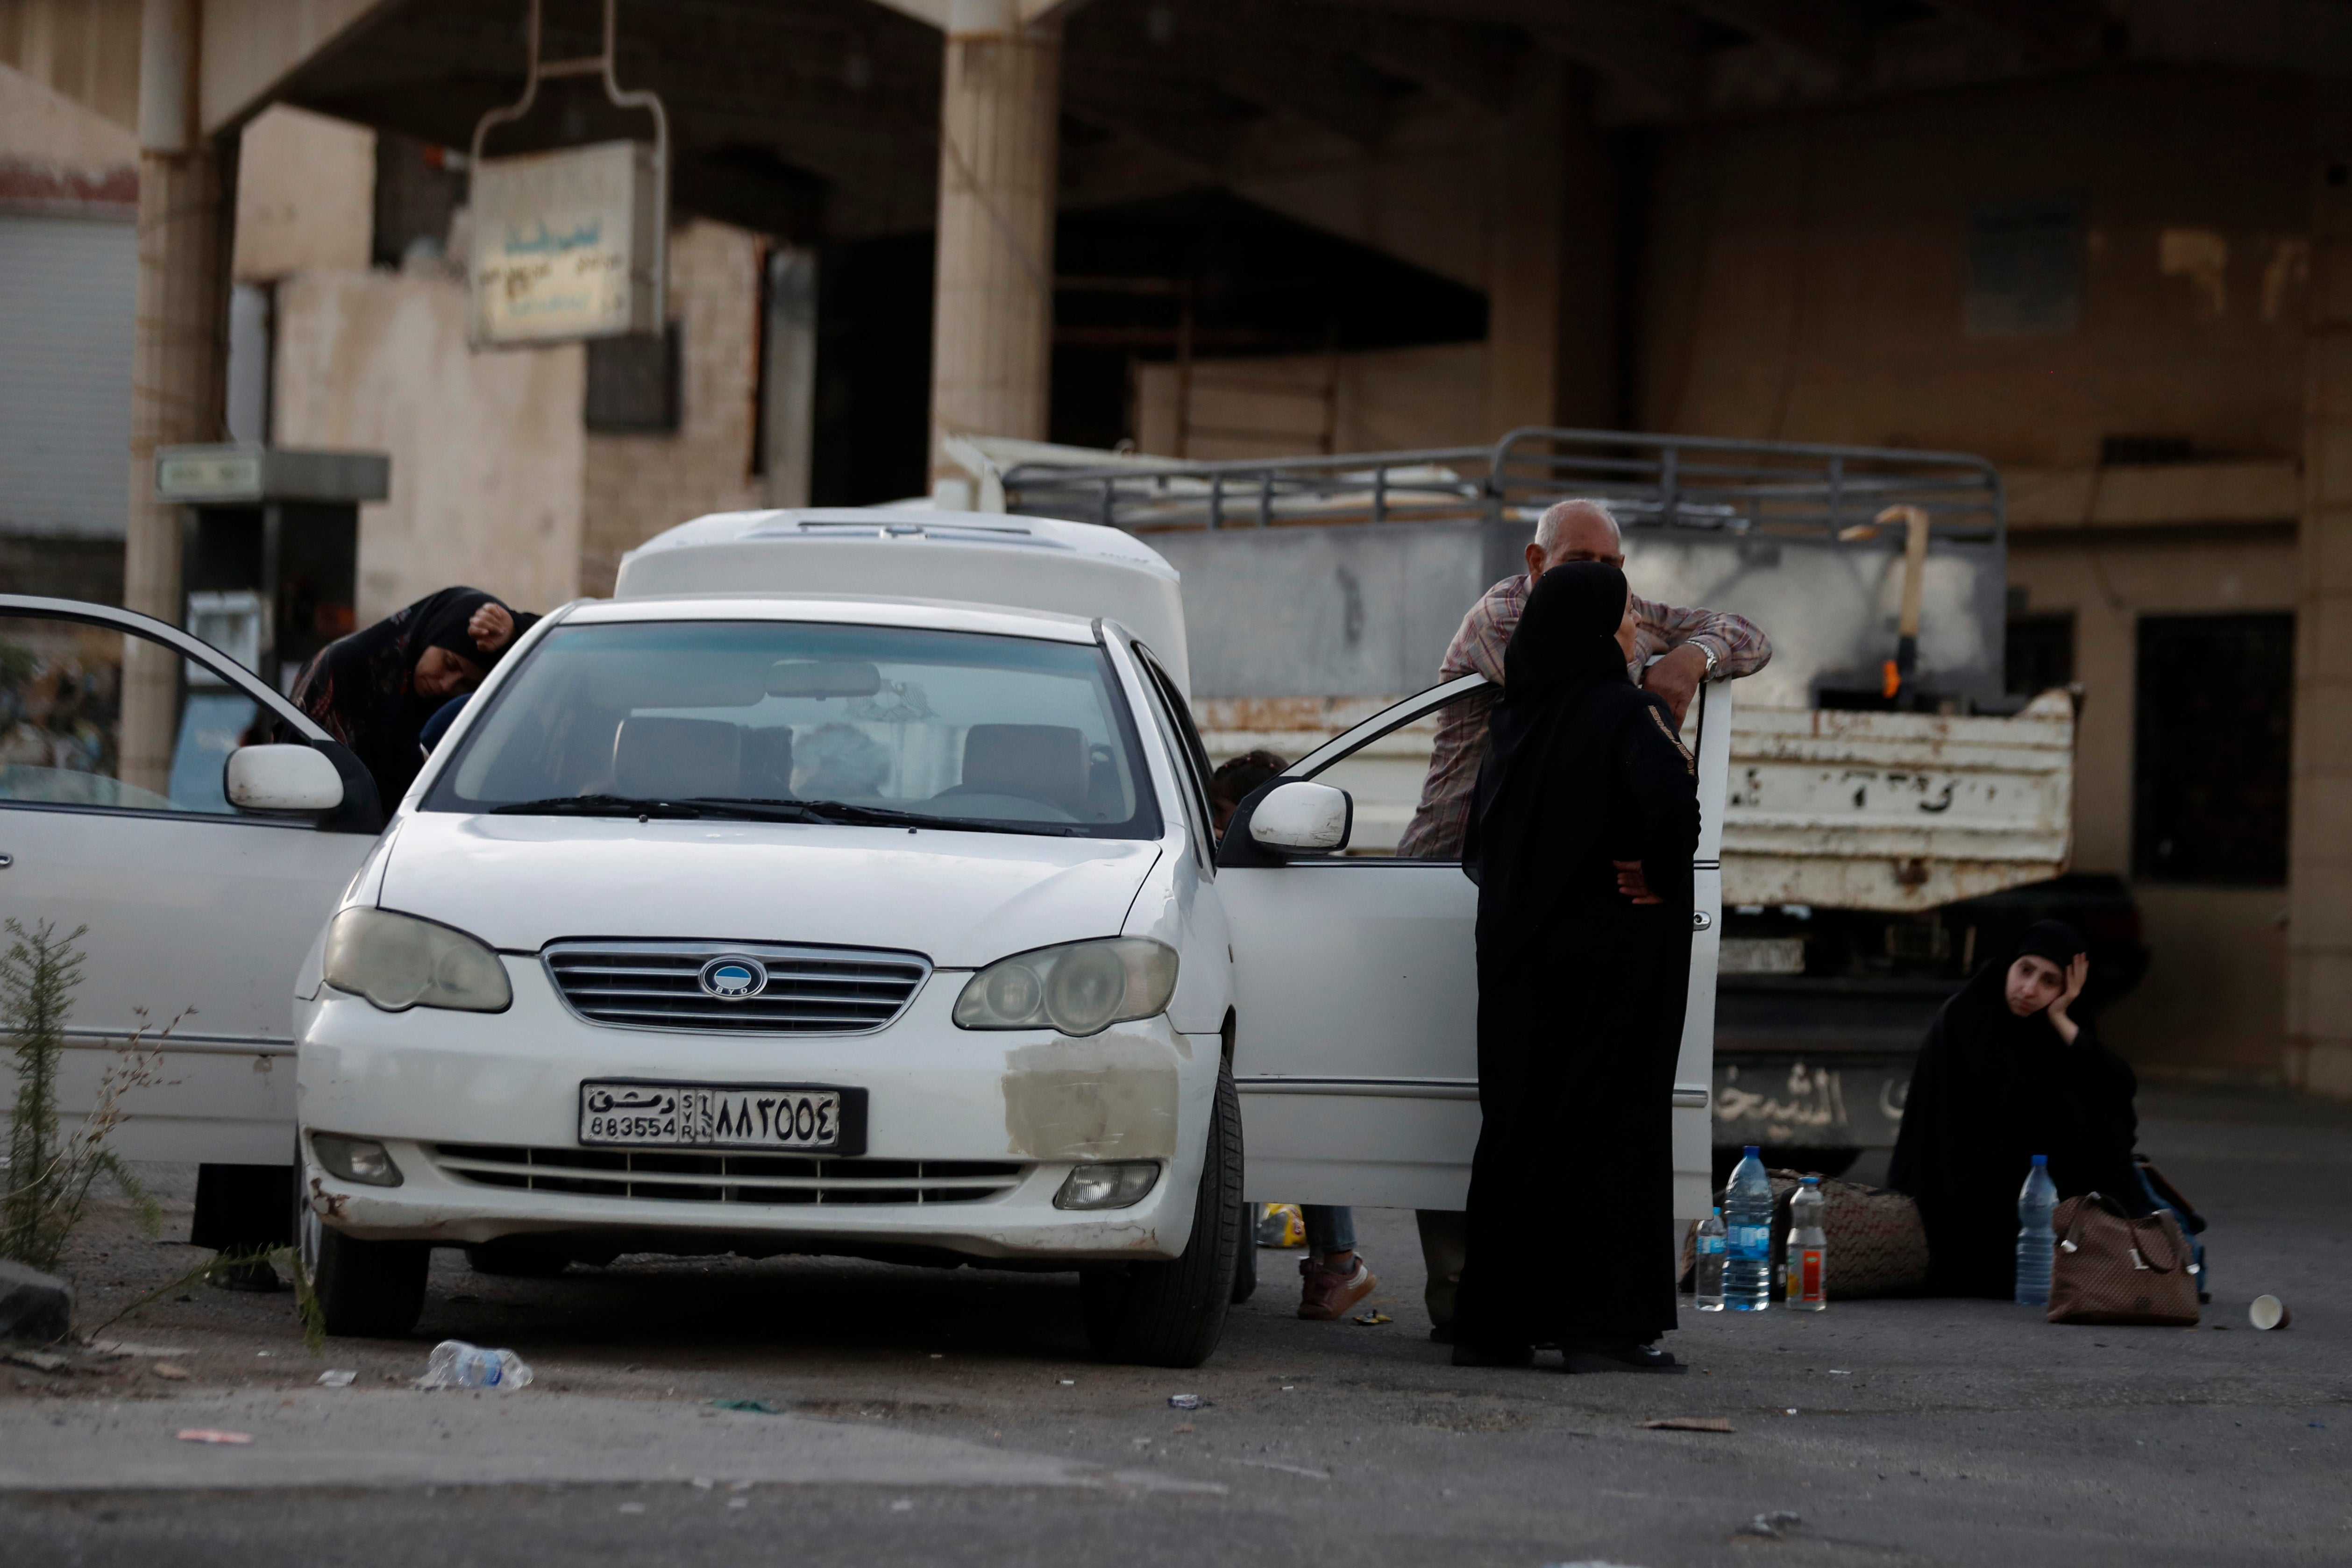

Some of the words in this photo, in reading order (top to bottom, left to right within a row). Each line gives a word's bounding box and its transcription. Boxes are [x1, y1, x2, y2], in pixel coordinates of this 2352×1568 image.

[716, 986, 748, 995] BYD
[589, 1090, 675, 1114] دمشق
[591, 1116, 676, 1137] 883554
[715, 1096, 834, 1140] ٨٨٣٥٥٤
